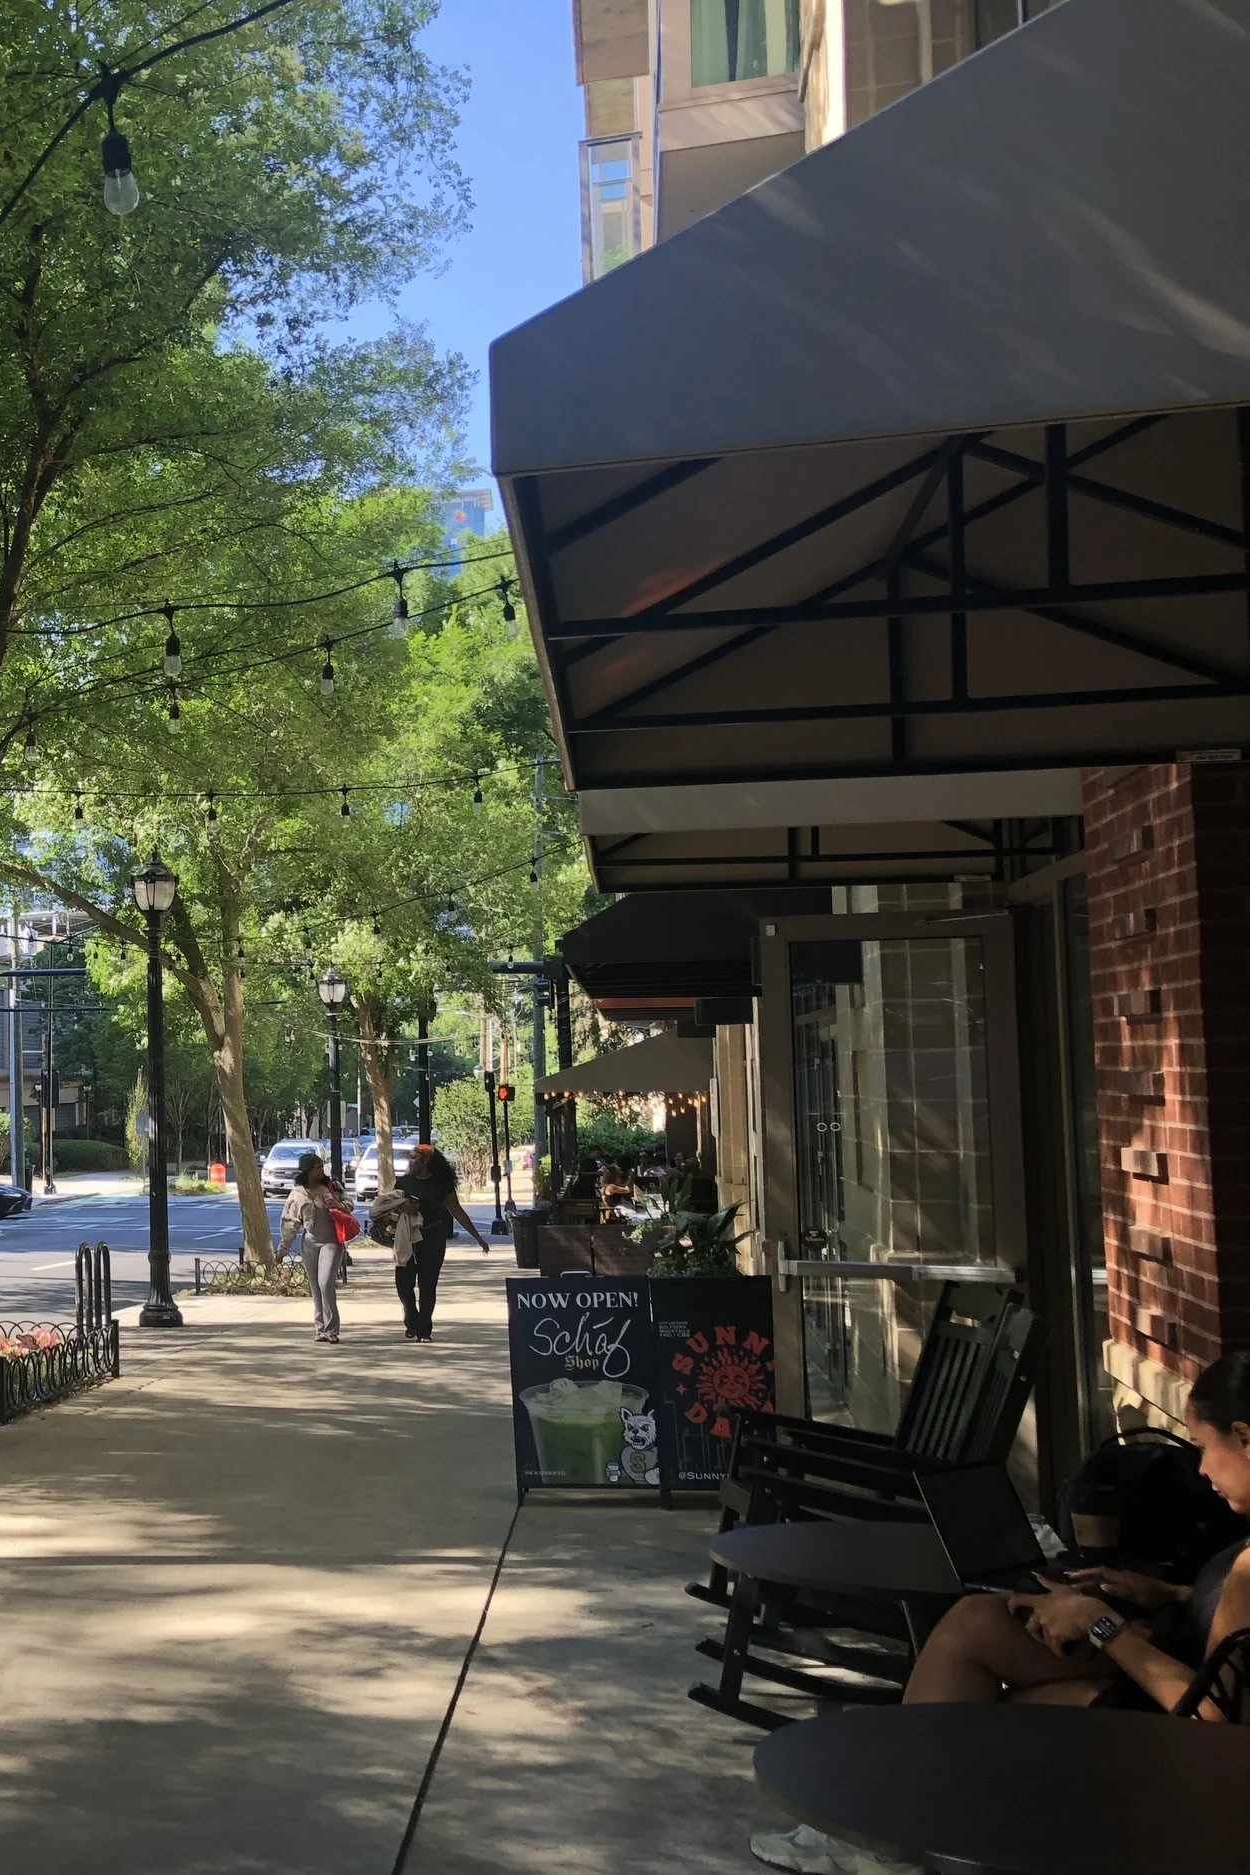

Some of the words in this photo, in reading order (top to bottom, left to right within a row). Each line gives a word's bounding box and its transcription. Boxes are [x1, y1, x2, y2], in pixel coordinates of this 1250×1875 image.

[517, 1292, 571, 1309] NOW
[575, 1291, 639, 1308] OPEN!
[565, 1355, 600, 1371] Shop
[630, 1451, 647, 1473] S
